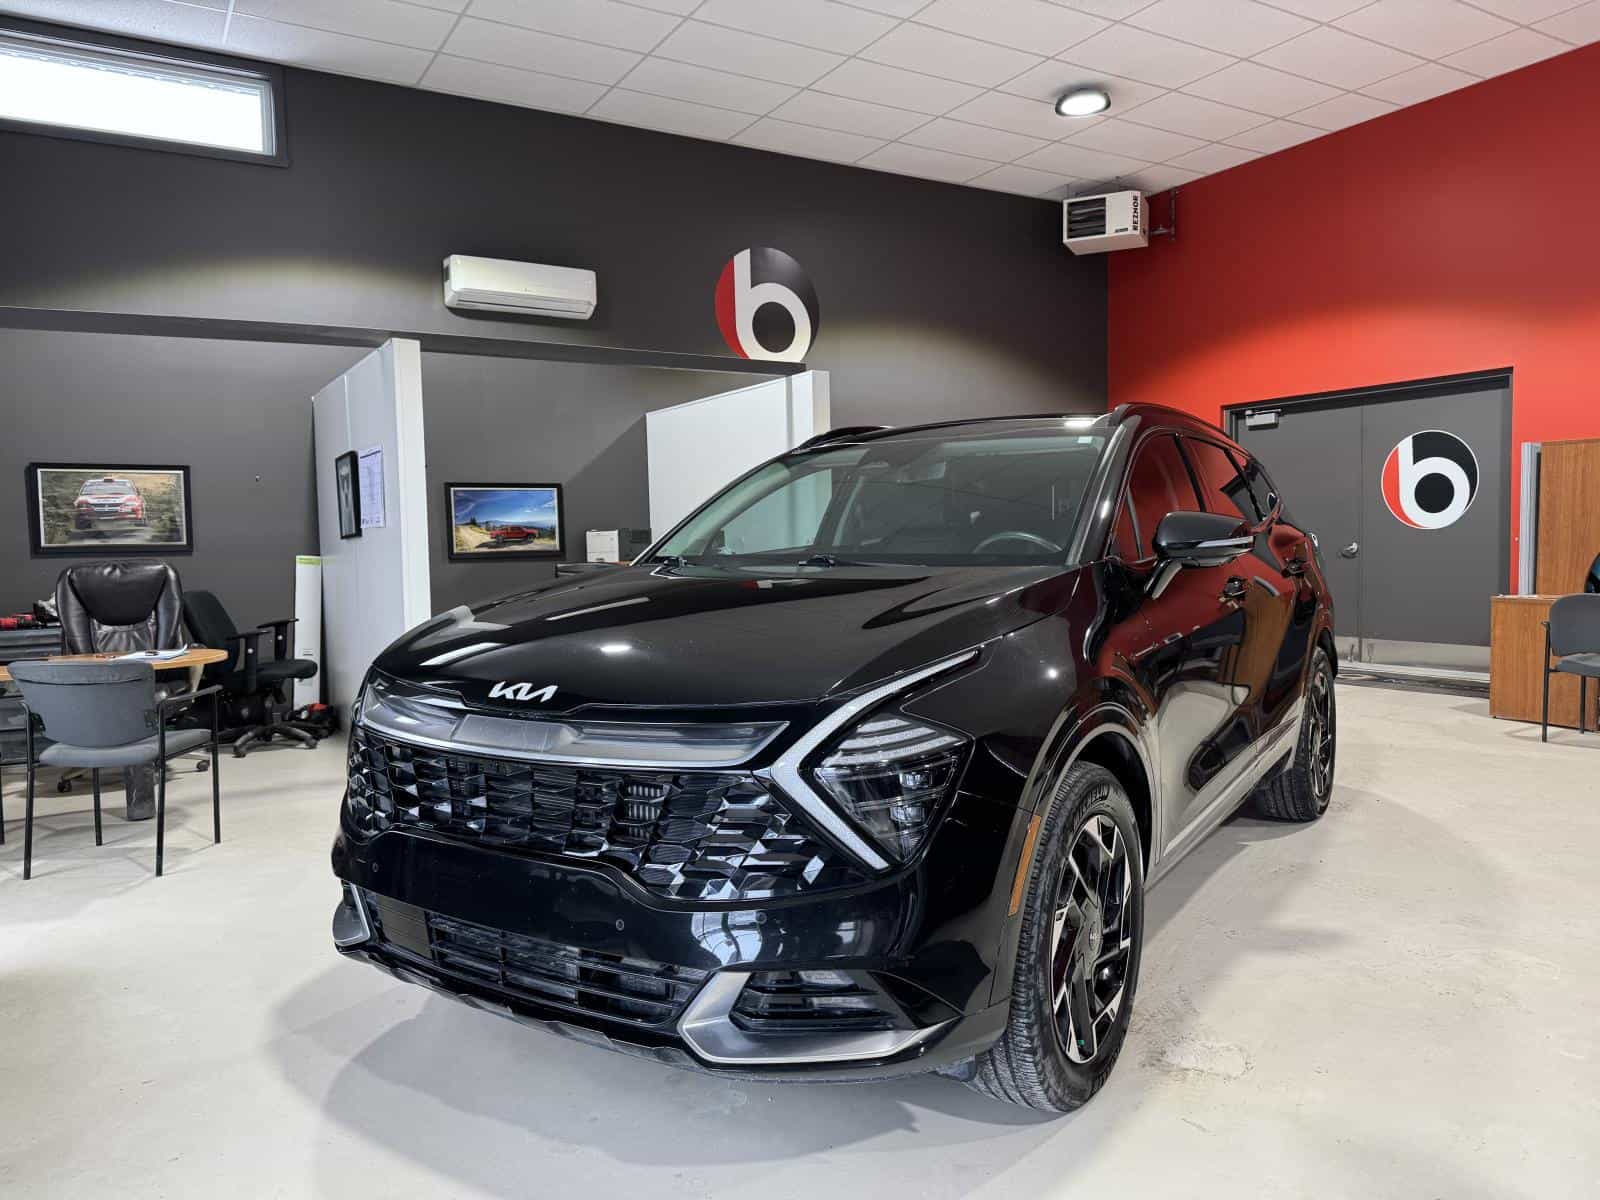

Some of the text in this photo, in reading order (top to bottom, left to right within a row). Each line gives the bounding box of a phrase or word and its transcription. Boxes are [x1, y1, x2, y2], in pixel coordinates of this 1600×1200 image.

[733, 248, 812, 363] b
[1397, 434, 1470, 529] b
[487, 680, 558, 703] KIA
